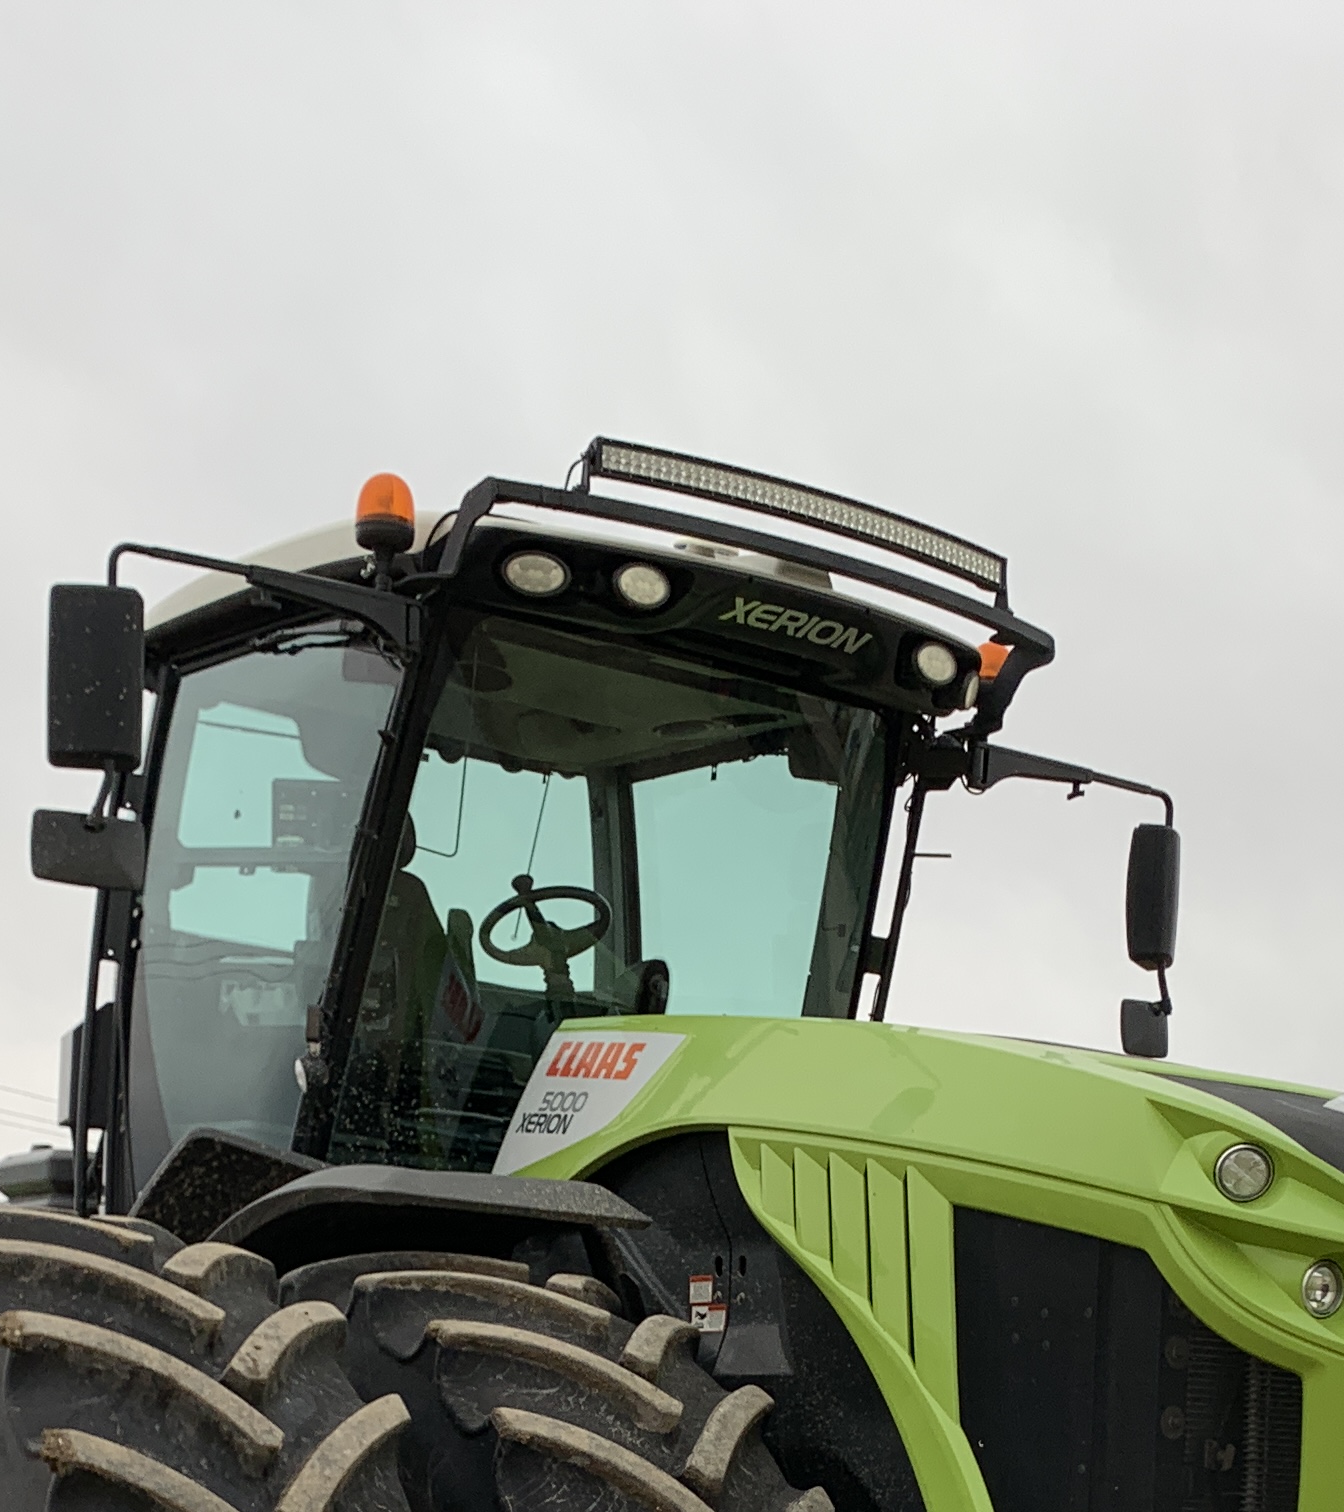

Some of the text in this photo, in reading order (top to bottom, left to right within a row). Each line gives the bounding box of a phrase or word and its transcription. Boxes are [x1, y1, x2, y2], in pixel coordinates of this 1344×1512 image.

[718, 596, 873, 655] XERION
[545, 1041, 647, 1081] CLAAS
[538, 1091, 589, 1113] 5000
[515, 1112, 574, 1135] XERION
